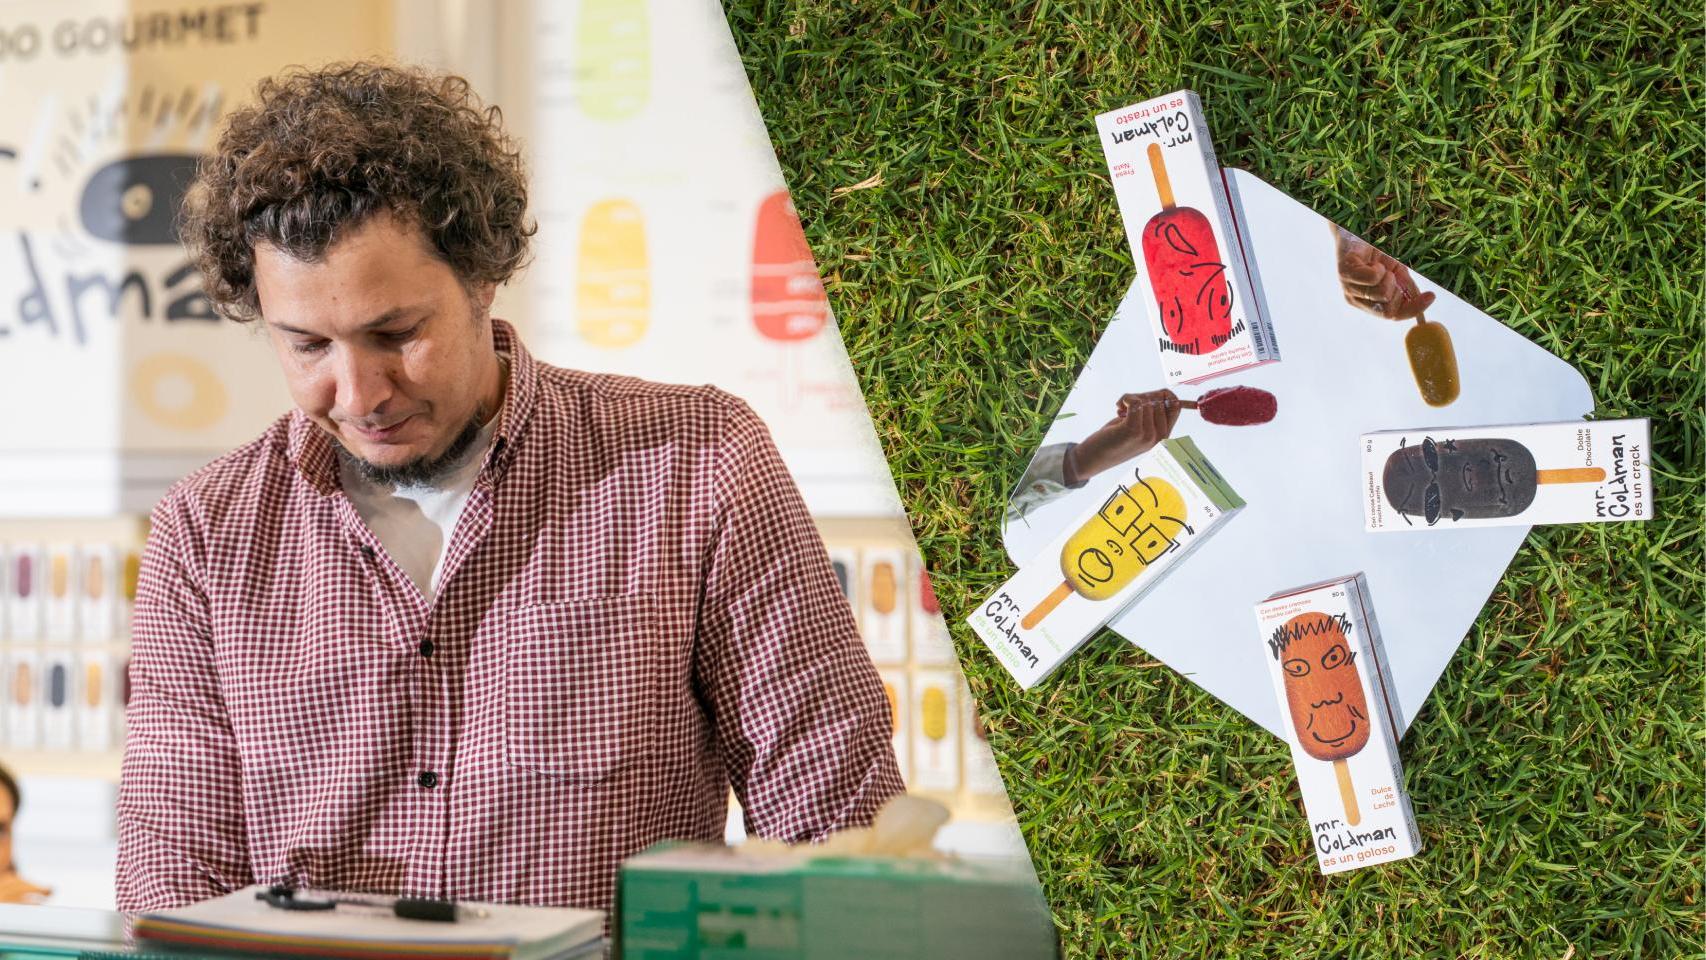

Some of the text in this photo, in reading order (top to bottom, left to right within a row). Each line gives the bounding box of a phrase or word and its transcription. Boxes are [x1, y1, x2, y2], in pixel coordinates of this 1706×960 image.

[52, 2, 266, 54] GOURMET
[1116, 98, 1184, 125] es un trasto
[1163, 132, 1193, 148] mr.
[1113, 162, 1131, 171] Nata
[1115, 169, 1135, 178] Fresa
[1585, 428, 1593, 467] Chocolate
[1629, 444, 1643, 516] es un crack
[1595, 485, 1606, 518] mr.
[999, 592, 1020, 618] mr.
[1371, 785, 1393, 795] Dulce
[1373, 800, 1396, 810] Leche
[1315, 819, 1344, 833] mr.
[1323, 845, 1395, 867] es un goloso
